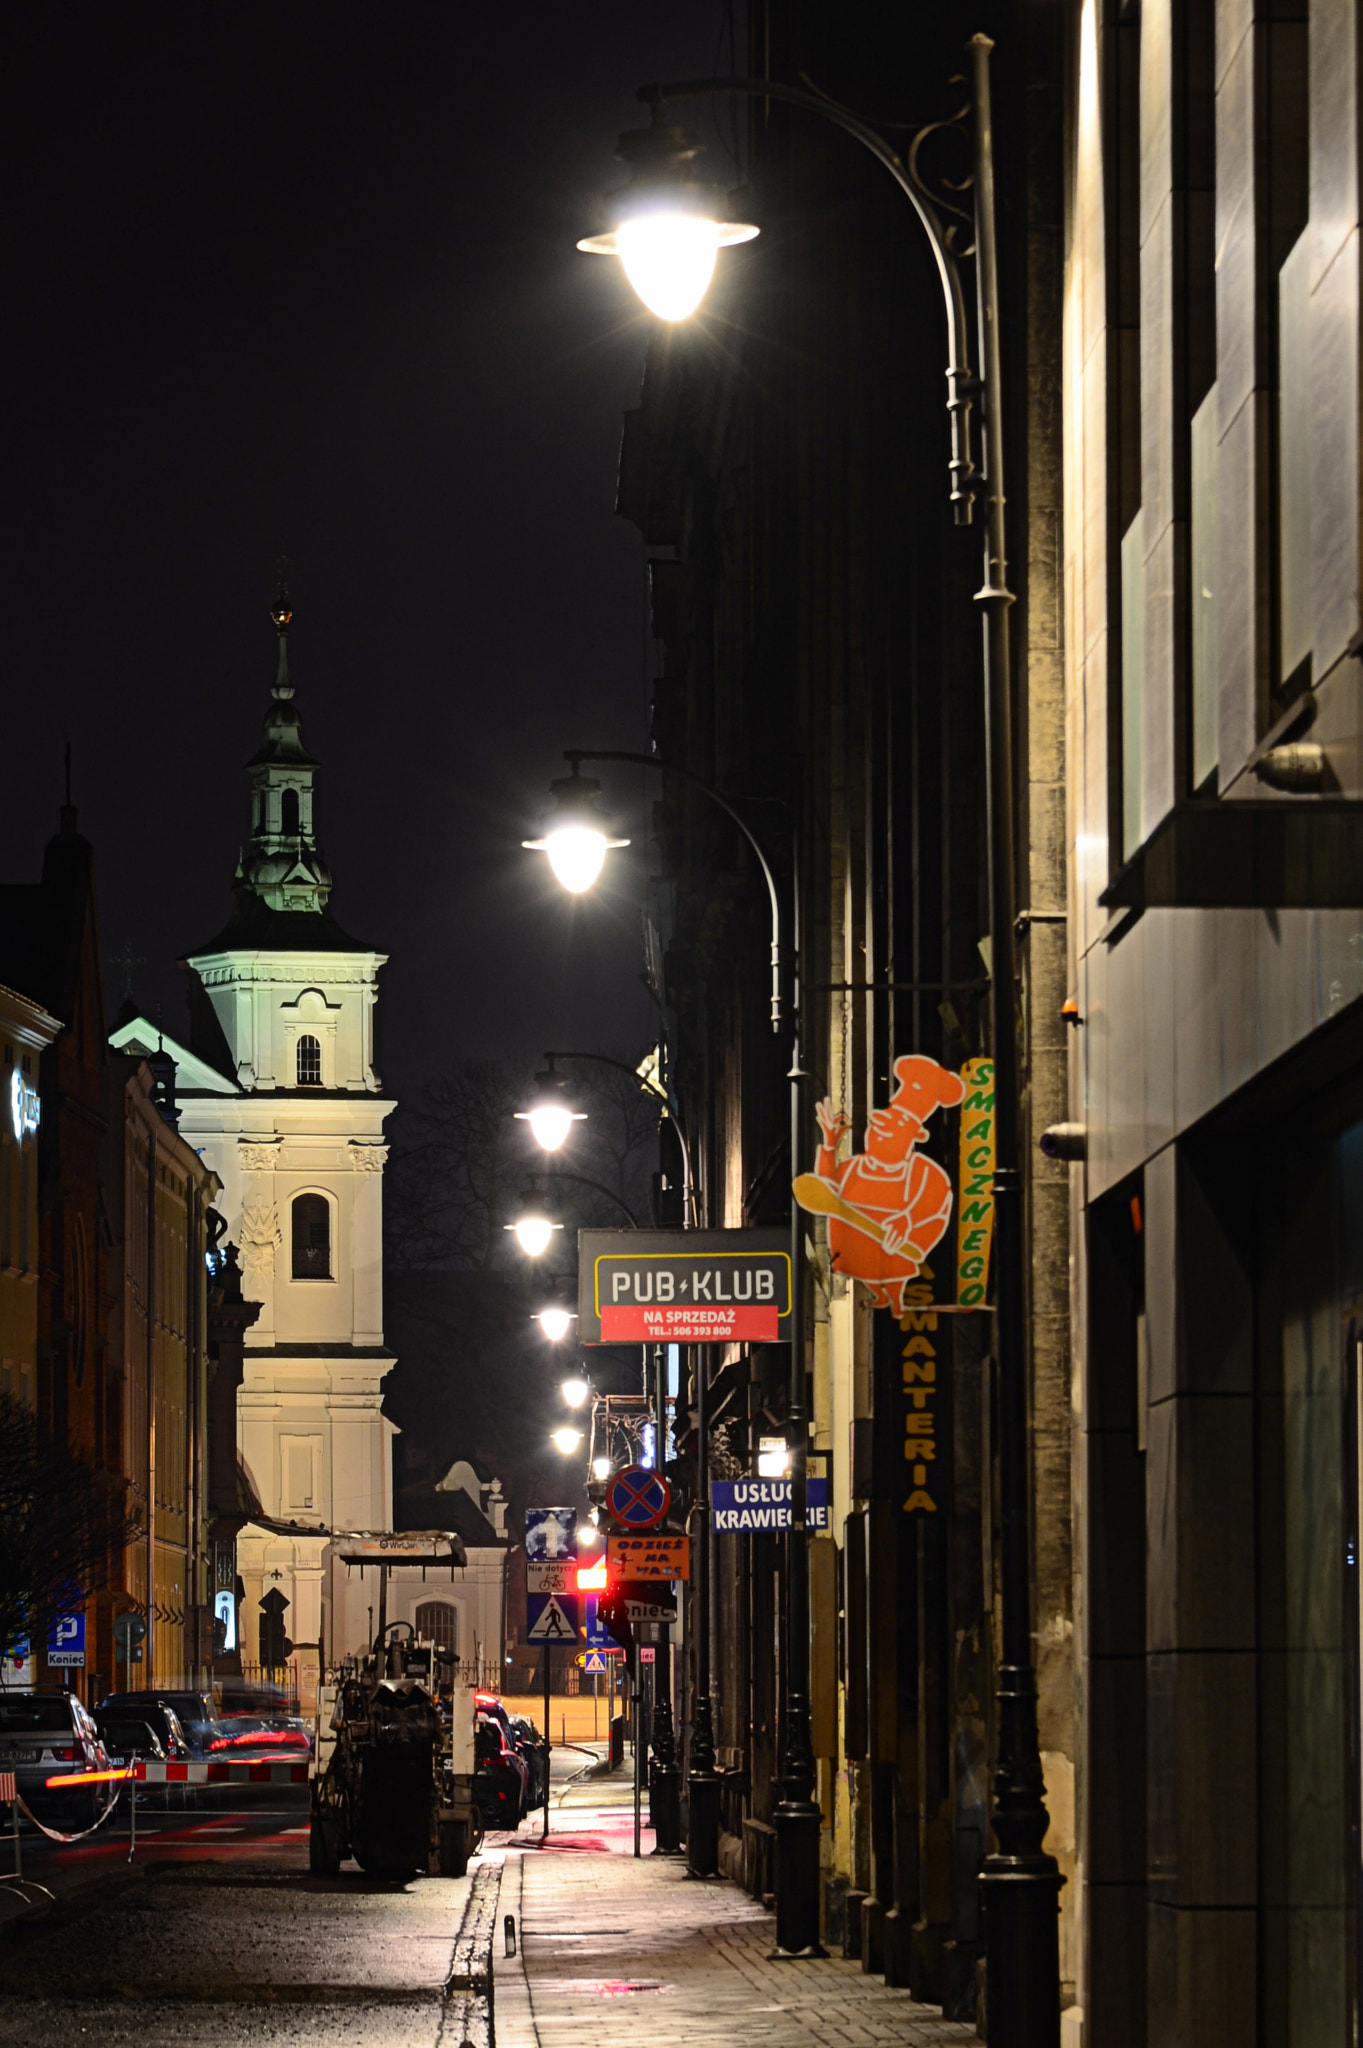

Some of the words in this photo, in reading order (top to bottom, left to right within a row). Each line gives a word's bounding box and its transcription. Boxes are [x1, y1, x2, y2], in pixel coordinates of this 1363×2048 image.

[958, 1063, 995, 1306] SMACZNEGO
[612, 1271, 675, 1302] PUB
[692, 1269, 774, 1301] KLUB
[643, 1311, 664, 1323] NA
[666, 1309, 736, 1323] SPRZEDAŻ
[648, 1326, 672, 1335] TEL.:
[673, 1326, 691, 1335] 506
[693, 1326, 712, 1335] 393
[713, 1326, 731, 1335] 800
[617, 1538, 685, 1550] ODZIEŻ
[644, 1553, 670, 1562] NA
[528, 1564, 543, 1572] Nie
[545, 1564, 576, 1573] dotyczy
[636, 1566, 682, 1578] WAGĘ
[56, 1616, 78, 1647] P
[49, 1653, 84, 1664] Koniec
